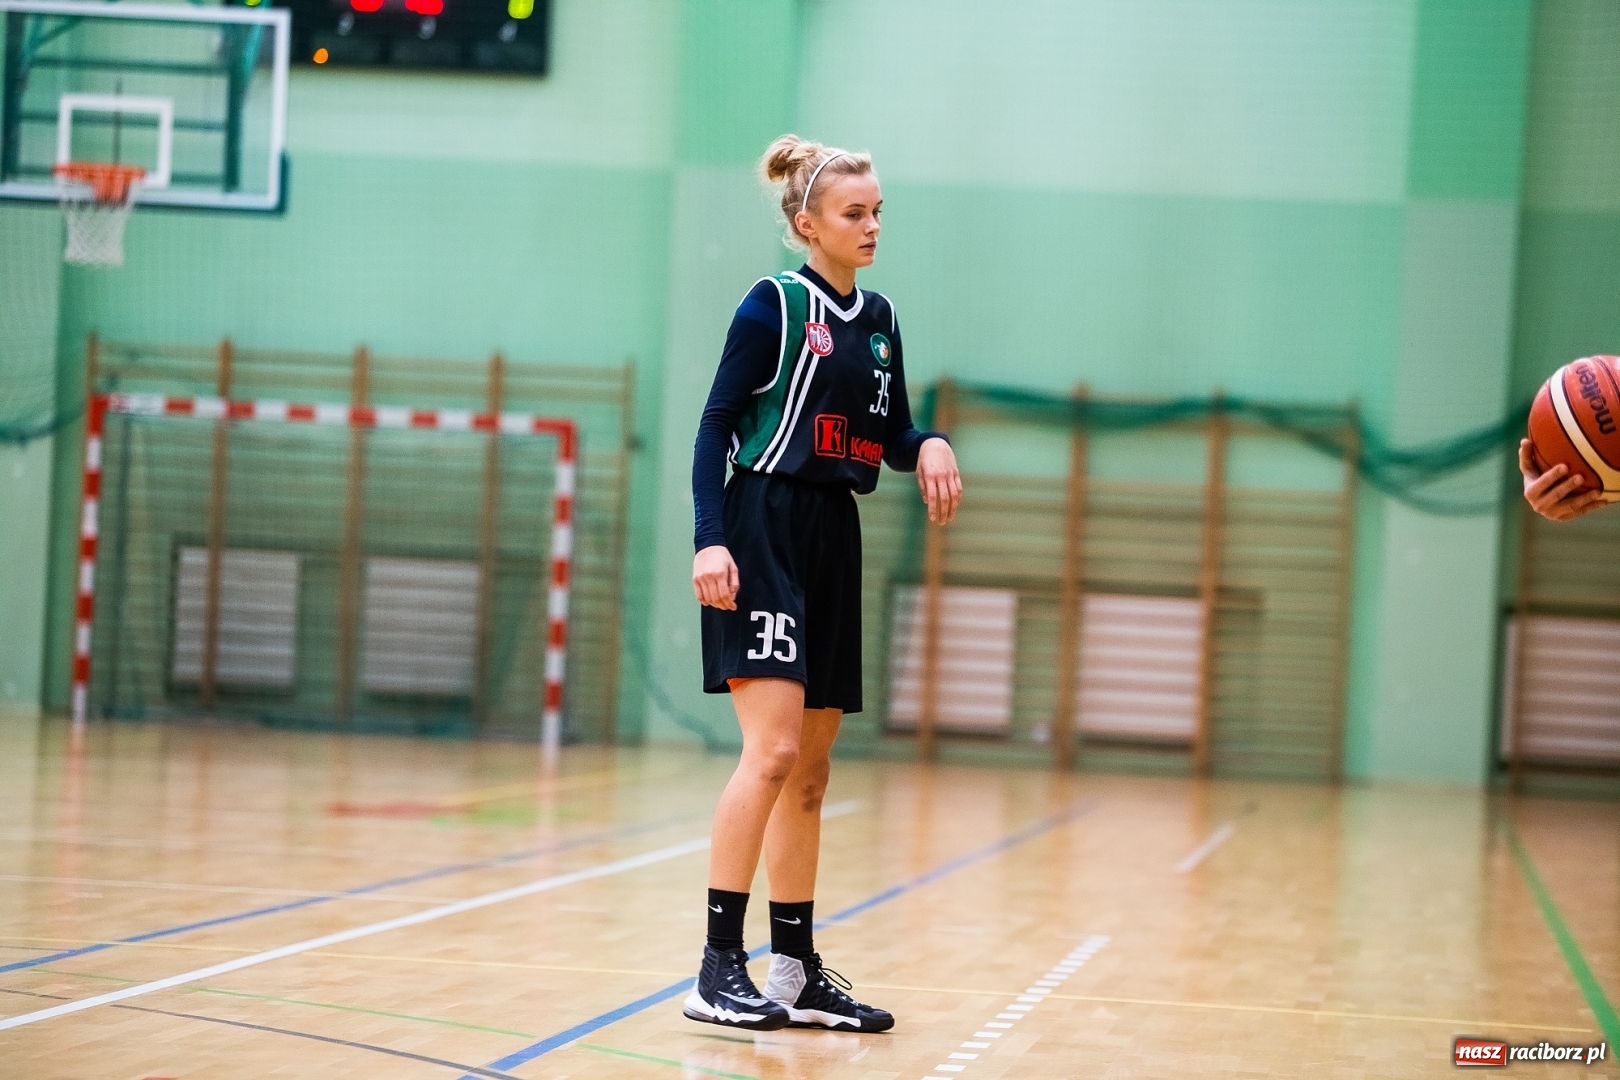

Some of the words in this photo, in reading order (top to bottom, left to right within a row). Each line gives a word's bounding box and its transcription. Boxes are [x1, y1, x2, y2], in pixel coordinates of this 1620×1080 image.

[869, 369, 891, 417] 35
[1576, 364, 1617, 435] molten
[818, 419, 843, 453] K
[747, 611, 797, 662] 35
